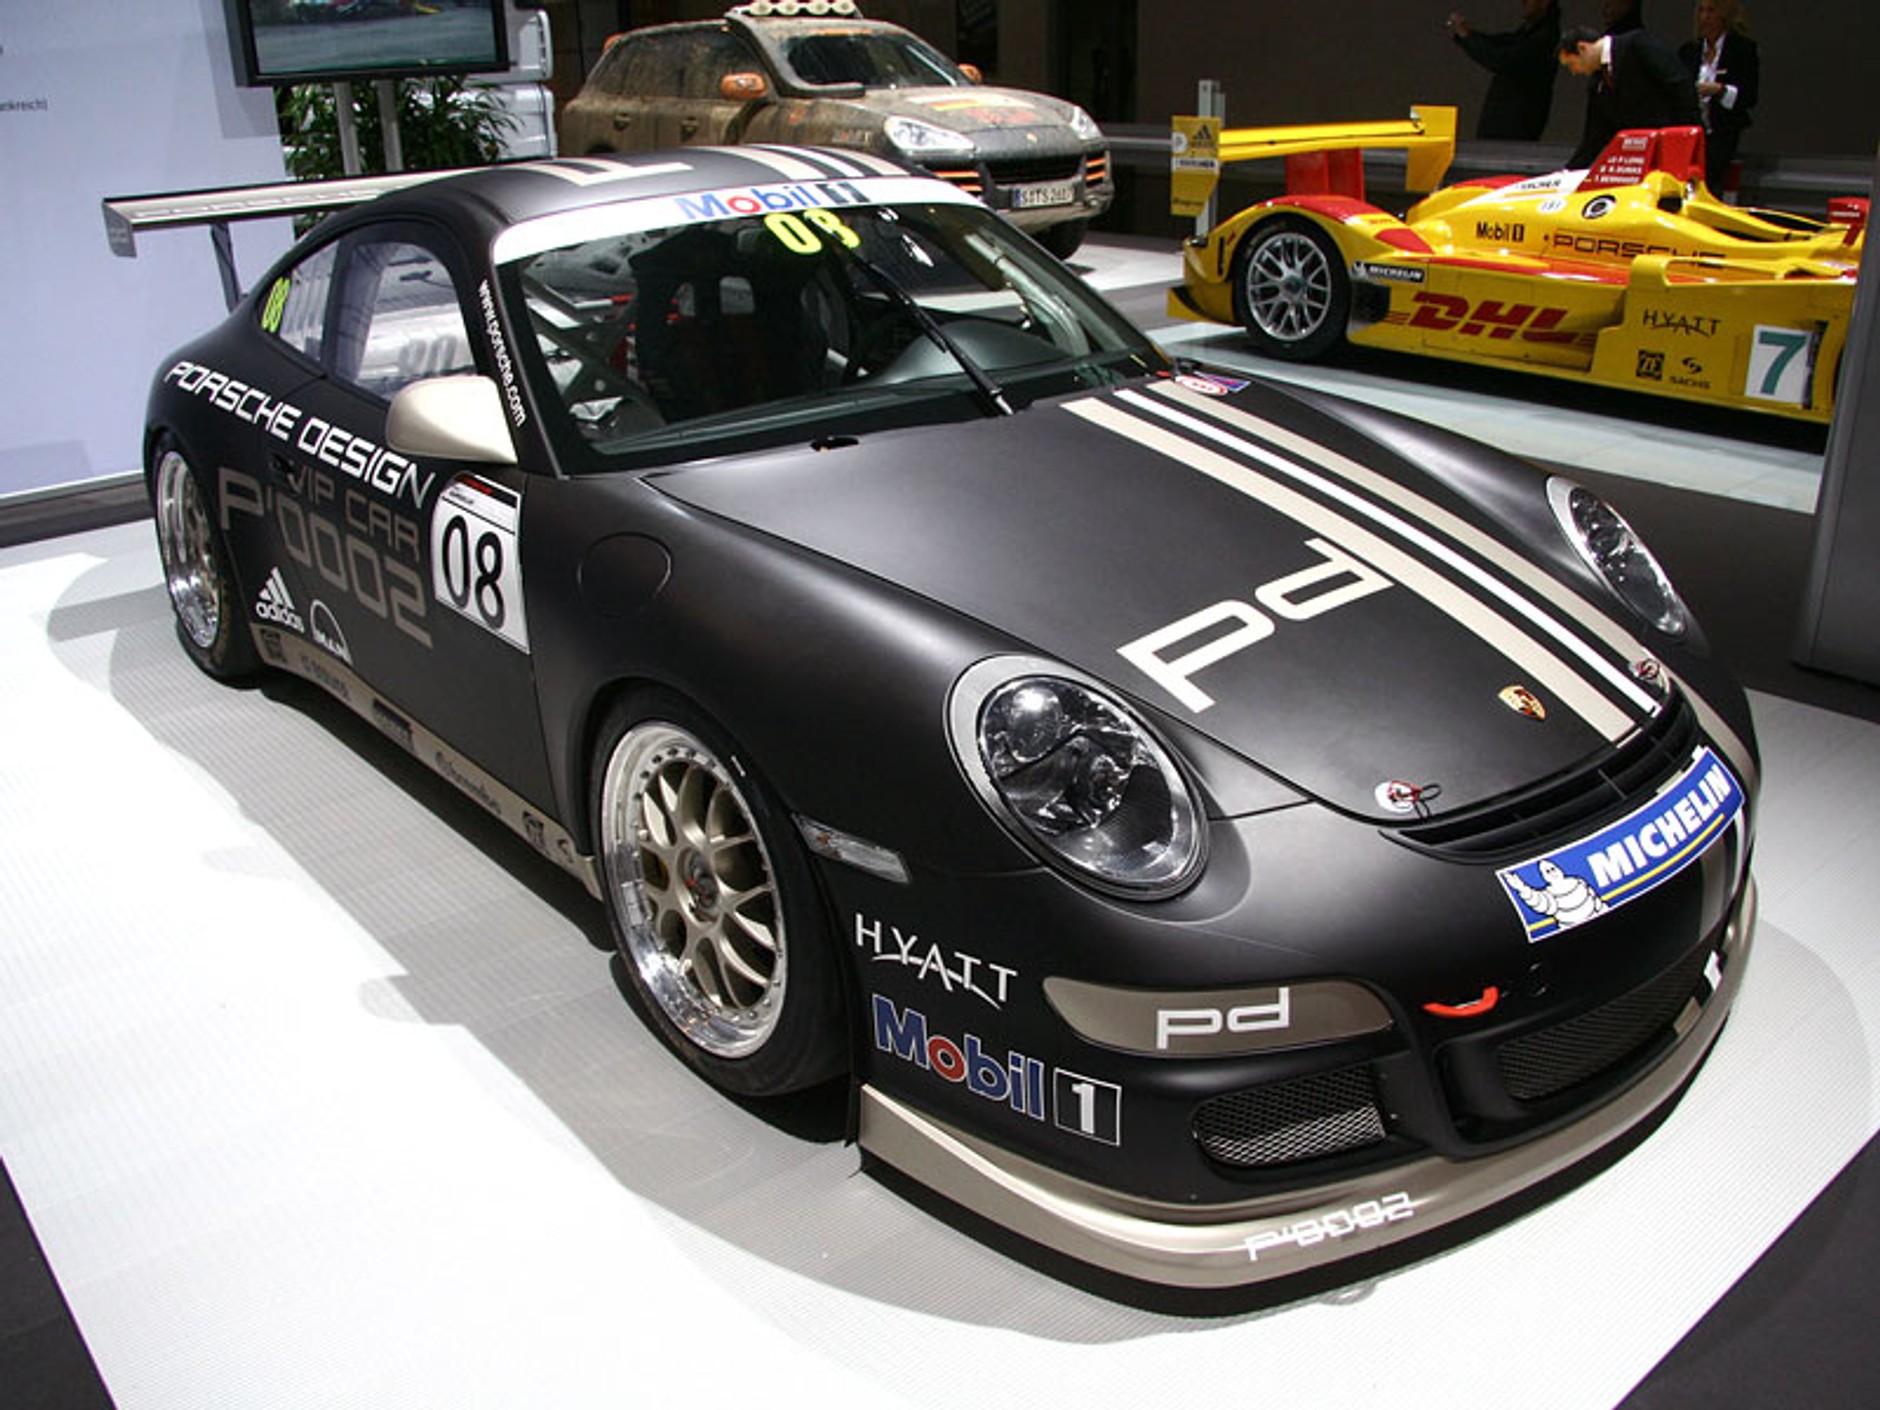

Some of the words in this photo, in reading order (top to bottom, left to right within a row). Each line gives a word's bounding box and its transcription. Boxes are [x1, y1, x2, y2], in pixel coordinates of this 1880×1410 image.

[674, 184, 820, 220] Mobil
[1476, 222, 1509, 243] Mobil
[1408, 291, 1580, 344] DHL
[1642, 308, 1722, 339] HYATT
[1758, 330, 1808, 396] 7
[164, 361, 303, 442] PORSCHE
[297, 416, 437, 510] DESIGN
[345, 488, 421, 563] CAR
[442, 515, 507, 630] 08
[255, 601, 306, 635] adidas
[1587, 763, 1732, 889] MICHELIN
[856, 913, 1019, 1010] HYATT
[872, 993, 1044, 1122] Mobil
